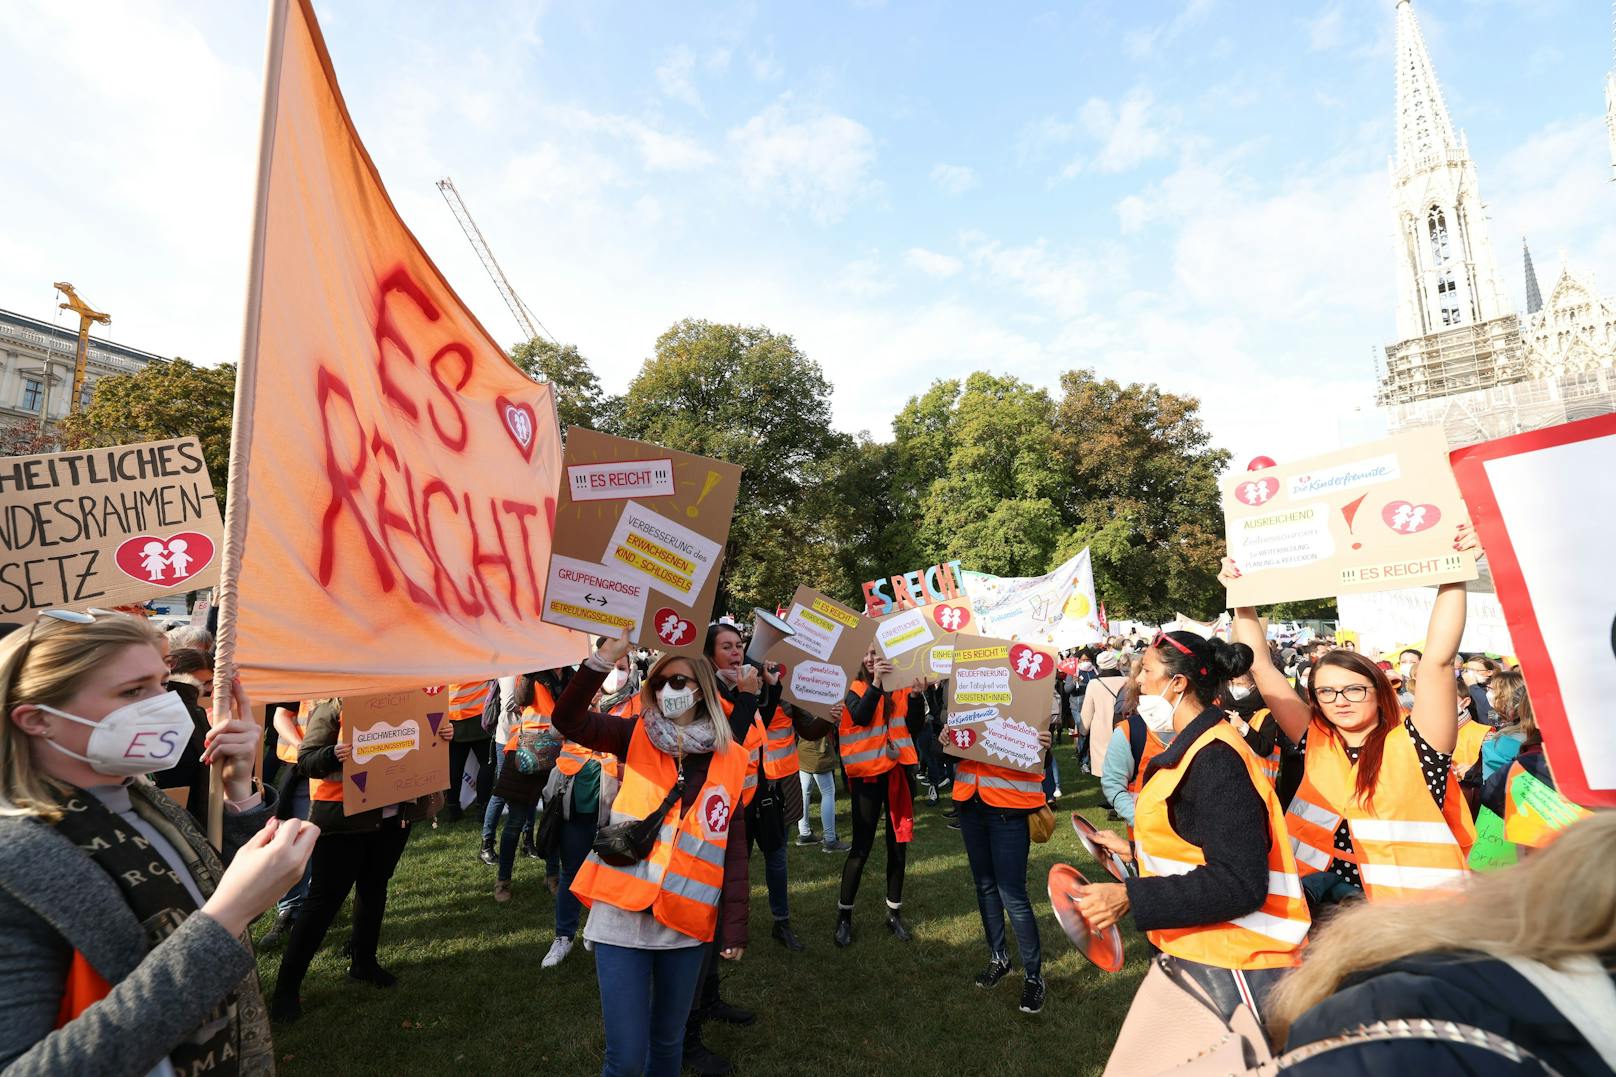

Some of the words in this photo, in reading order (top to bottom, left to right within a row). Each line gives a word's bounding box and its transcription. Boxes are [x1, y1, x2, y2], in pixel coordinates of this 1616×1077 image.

[375, 268, 473, 452] ES
[590, 474, 606, 489] ES
[610, 472, 652, 487] REICHT
[1309, 466, 1394, 491] Kinderfreunde
[1243, 509, 1314, 529] AUSREICHEND
[628, 515, 692, 555] VERBESSERUNG
[691, 548, 708, 563] des
[615, 547, 636, 563] KIND
[626, 534, 688, 571] ERWACHSENEN
[1360, 568, 1379, 581] ES
[1383, 559, 1441, 577] REICHT
[0, 550, 105, 613] SETZ
[862, 578, 893, 618] ES
[891, 560, 967, 610] REICHT
[820, 602, 829, 612] ES
[829, 607, 852, 623] REICHT
[932, 650, 952, 658] EINHE
[963, 651, 972, 660] ES
[973, 649, 998, 659] REICHT
[957, 669, 1008, 678] NEUDEFINIERUNG
[958, 682, 969, 690] der
[664, 695, 690, 712] REICHT
[124, 730, 179, 759] ES
[357, 727, 416, 743] GLEICHWERTIGES
[1027, 742, 1038, 751] von
